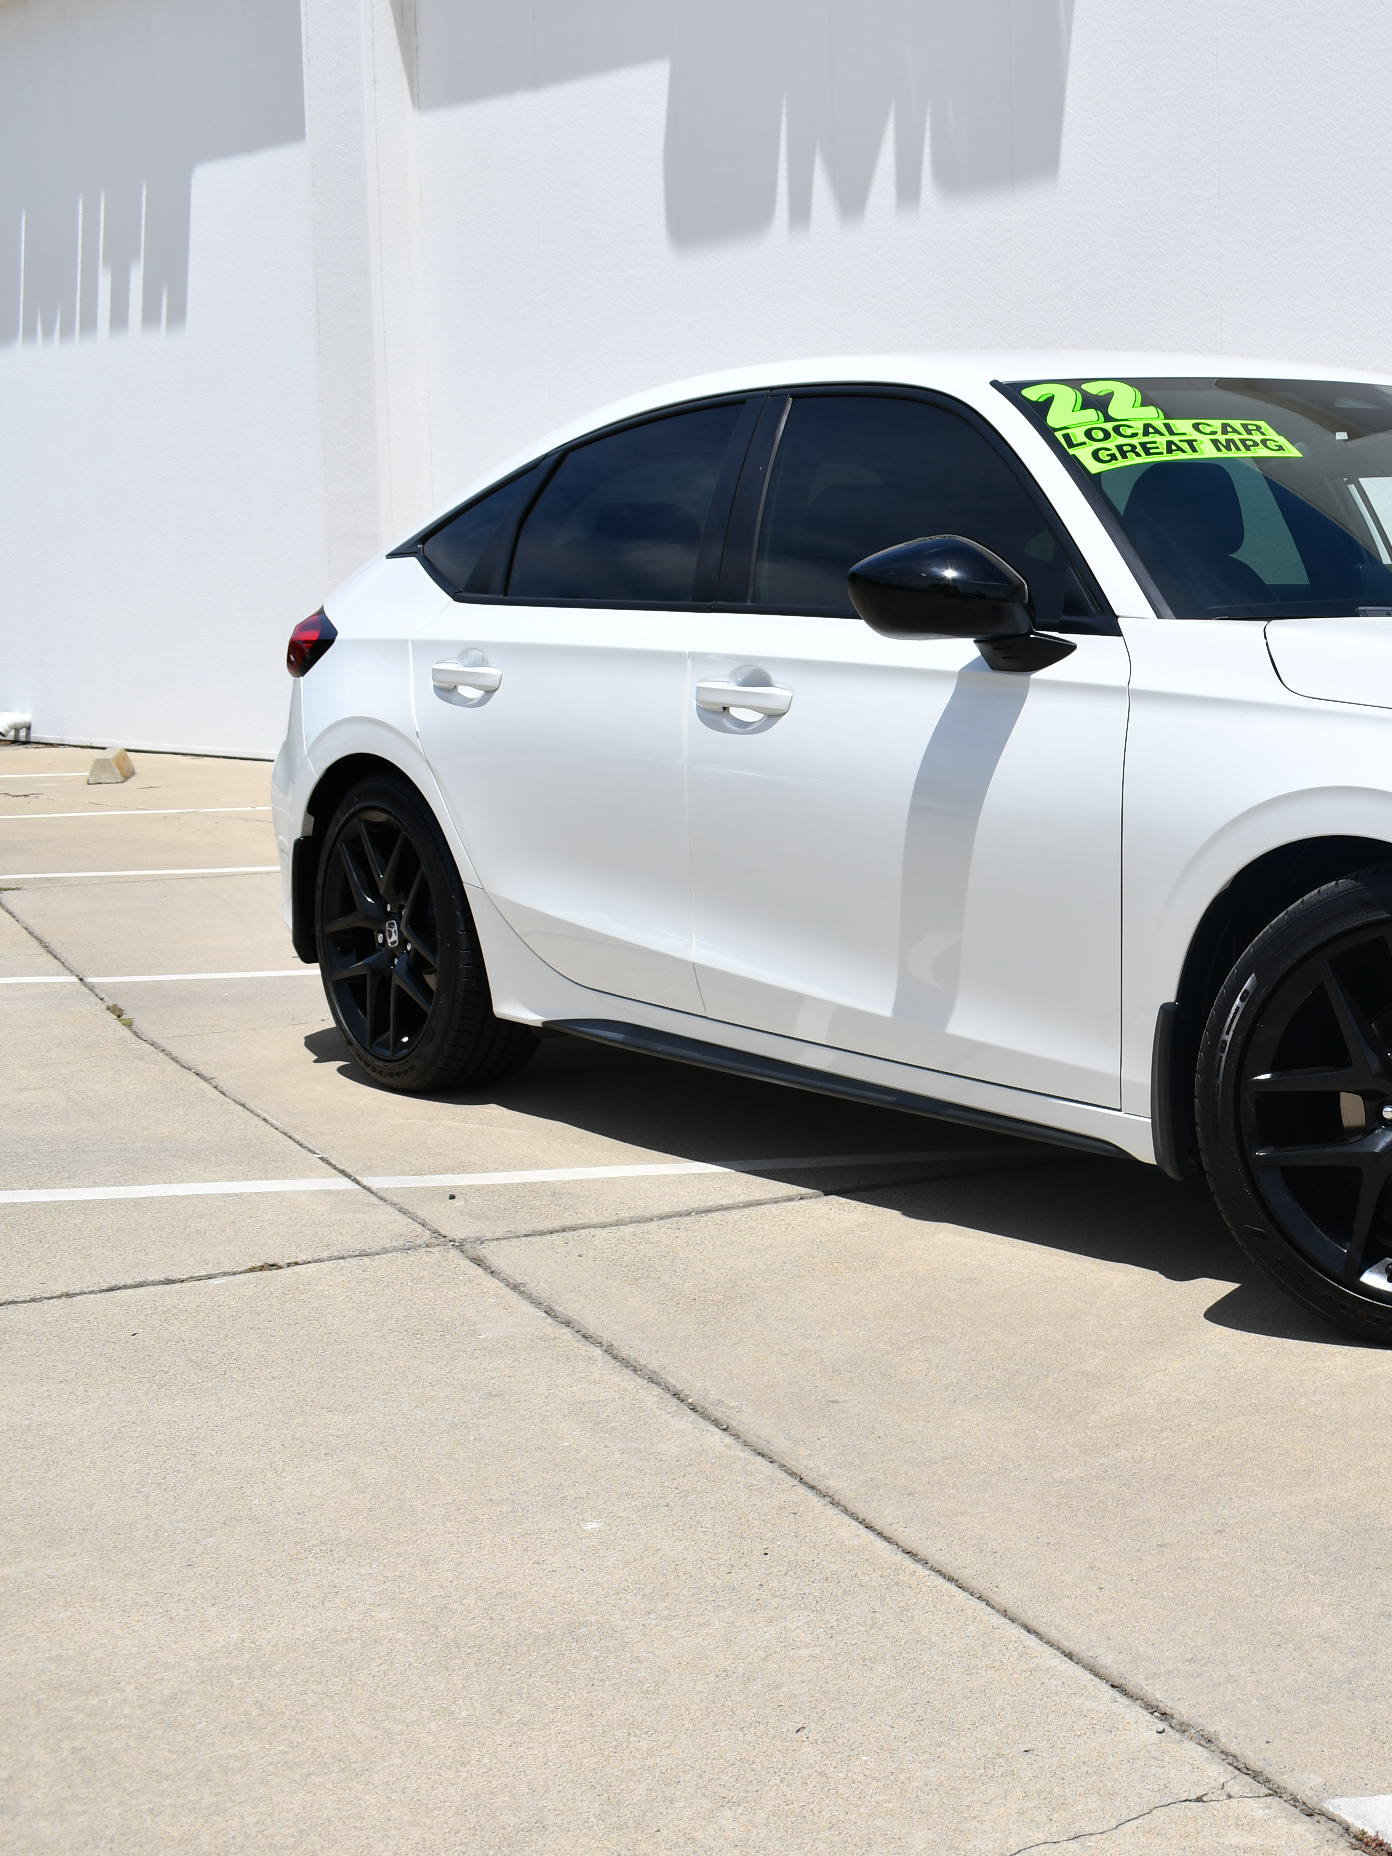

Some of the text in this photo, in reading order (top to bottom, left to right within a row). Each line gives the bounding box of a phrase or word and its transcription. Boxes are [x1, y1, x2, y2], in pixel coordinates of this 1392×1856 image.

[1020, 380, 1165, 430] 22
[1062, 421, 1269, 450] LOCAL CAR
[1091, 437, 1286, 464] GREAT MPG
